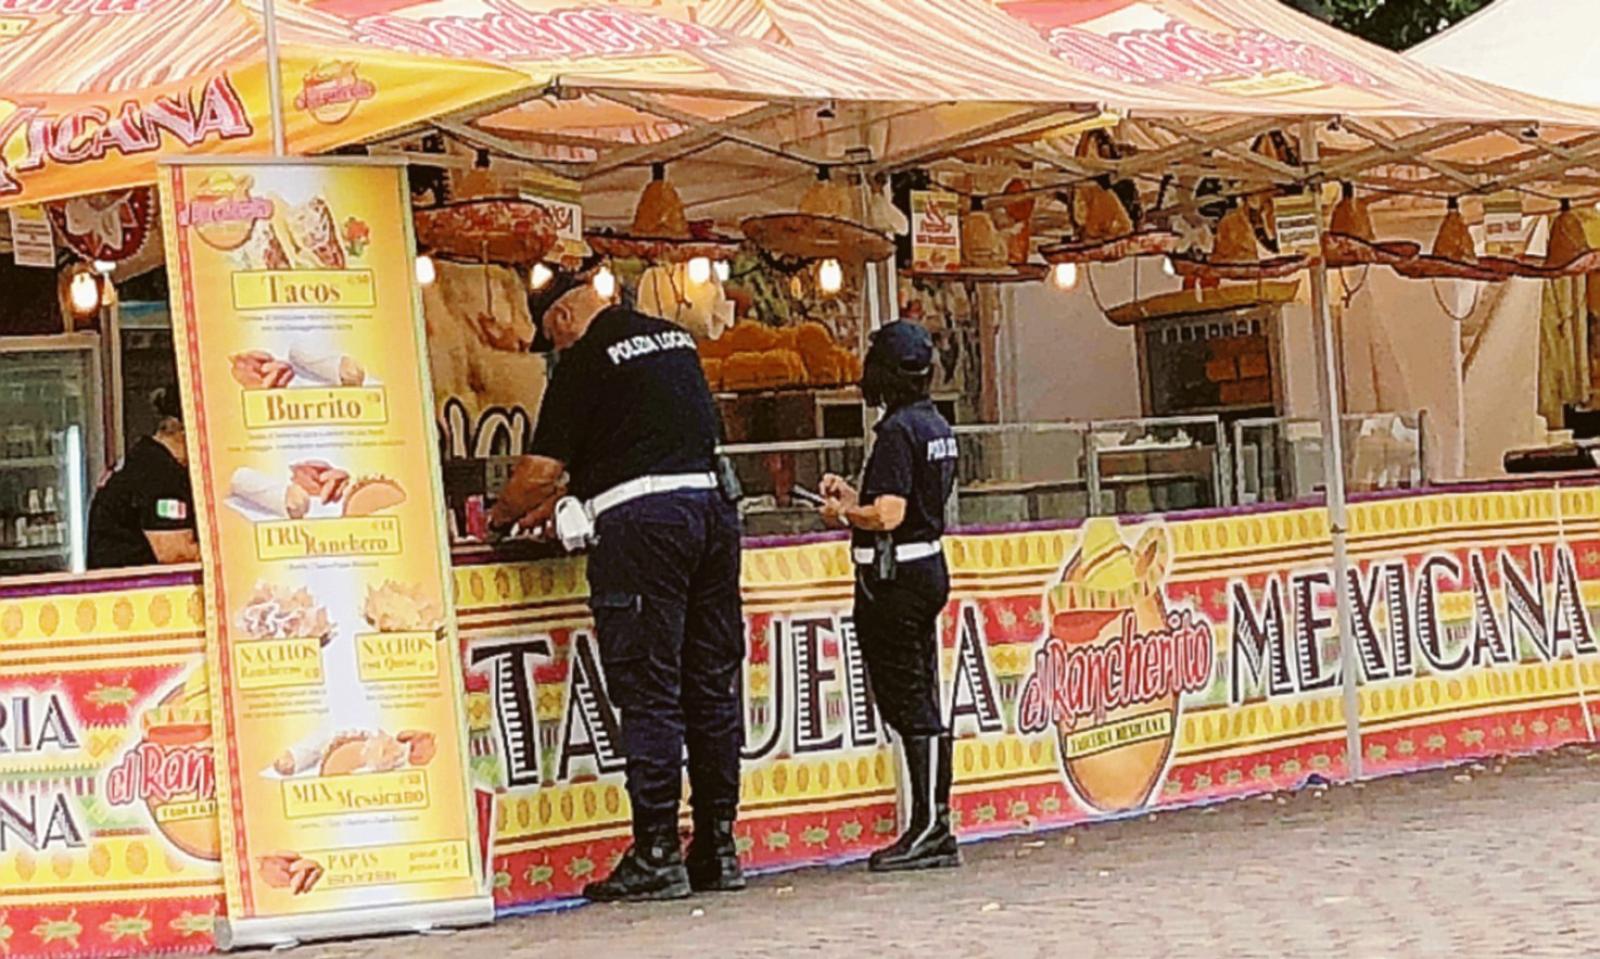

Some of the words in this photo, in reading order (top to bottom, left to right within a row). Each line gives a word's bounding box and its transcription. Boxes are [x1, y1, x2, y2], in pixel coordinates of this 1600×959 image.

[261, 274, 341, 303] Tacos
[266, 392, 361, 421] Burrito
[306, 533, 389, 555] Ranchero
[241, 644, 318, 663] NACHOS
[363, 637, 434, 655] NACHOS
[471, 606, 1003, 787] TAUEA
[1230, 547, 1598, 703] MEXICANA
[1049, 608, 1212, 727] Rancherito
[138, 741, 215, 802] Ran
[292, 782, 333, 803] MIX
[328, 853, 379, 869] PAPAS
